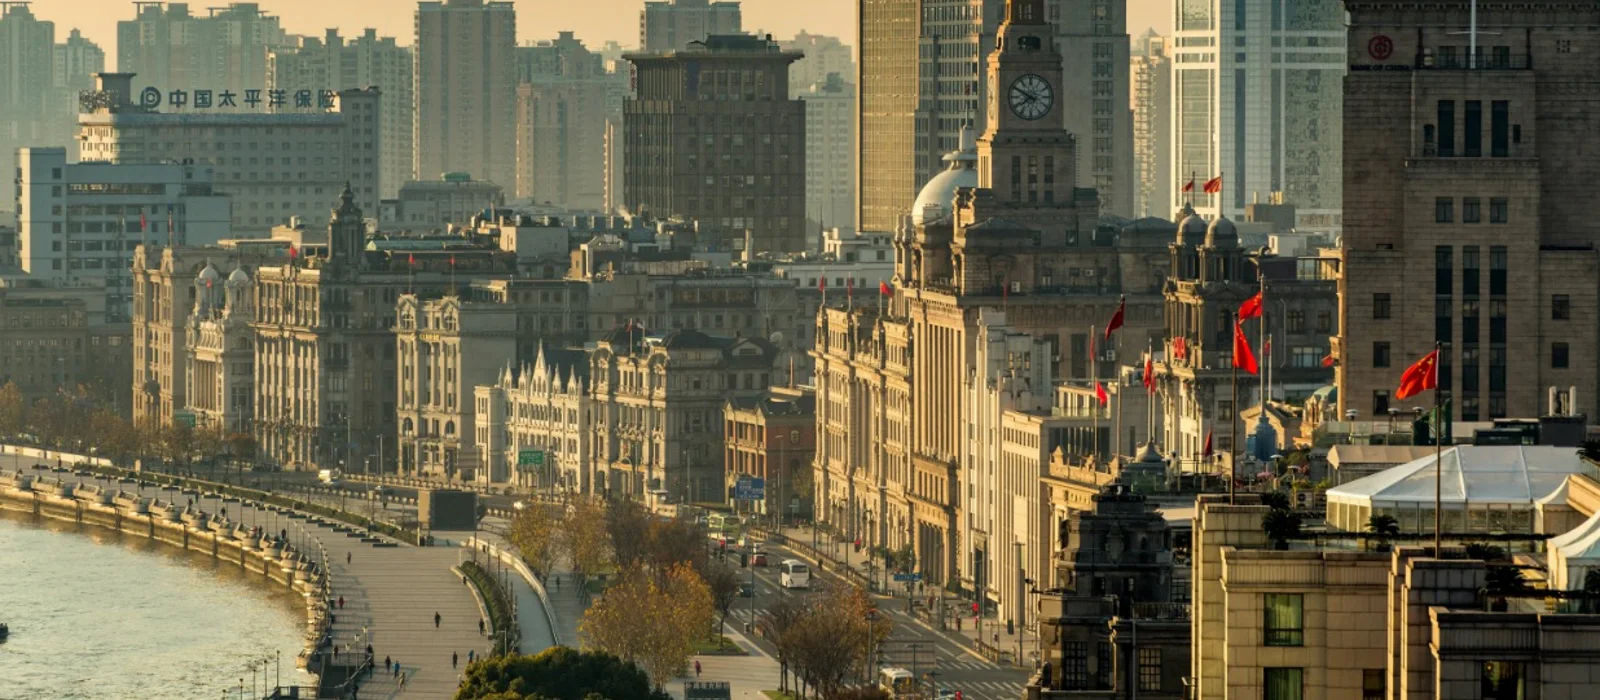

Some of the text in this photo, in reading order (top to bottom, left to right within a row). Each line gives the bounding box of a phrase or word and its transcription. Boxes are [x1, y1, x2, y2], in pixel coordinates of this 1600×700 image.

[169, 89, 336, 108] 中国太平洋保险
